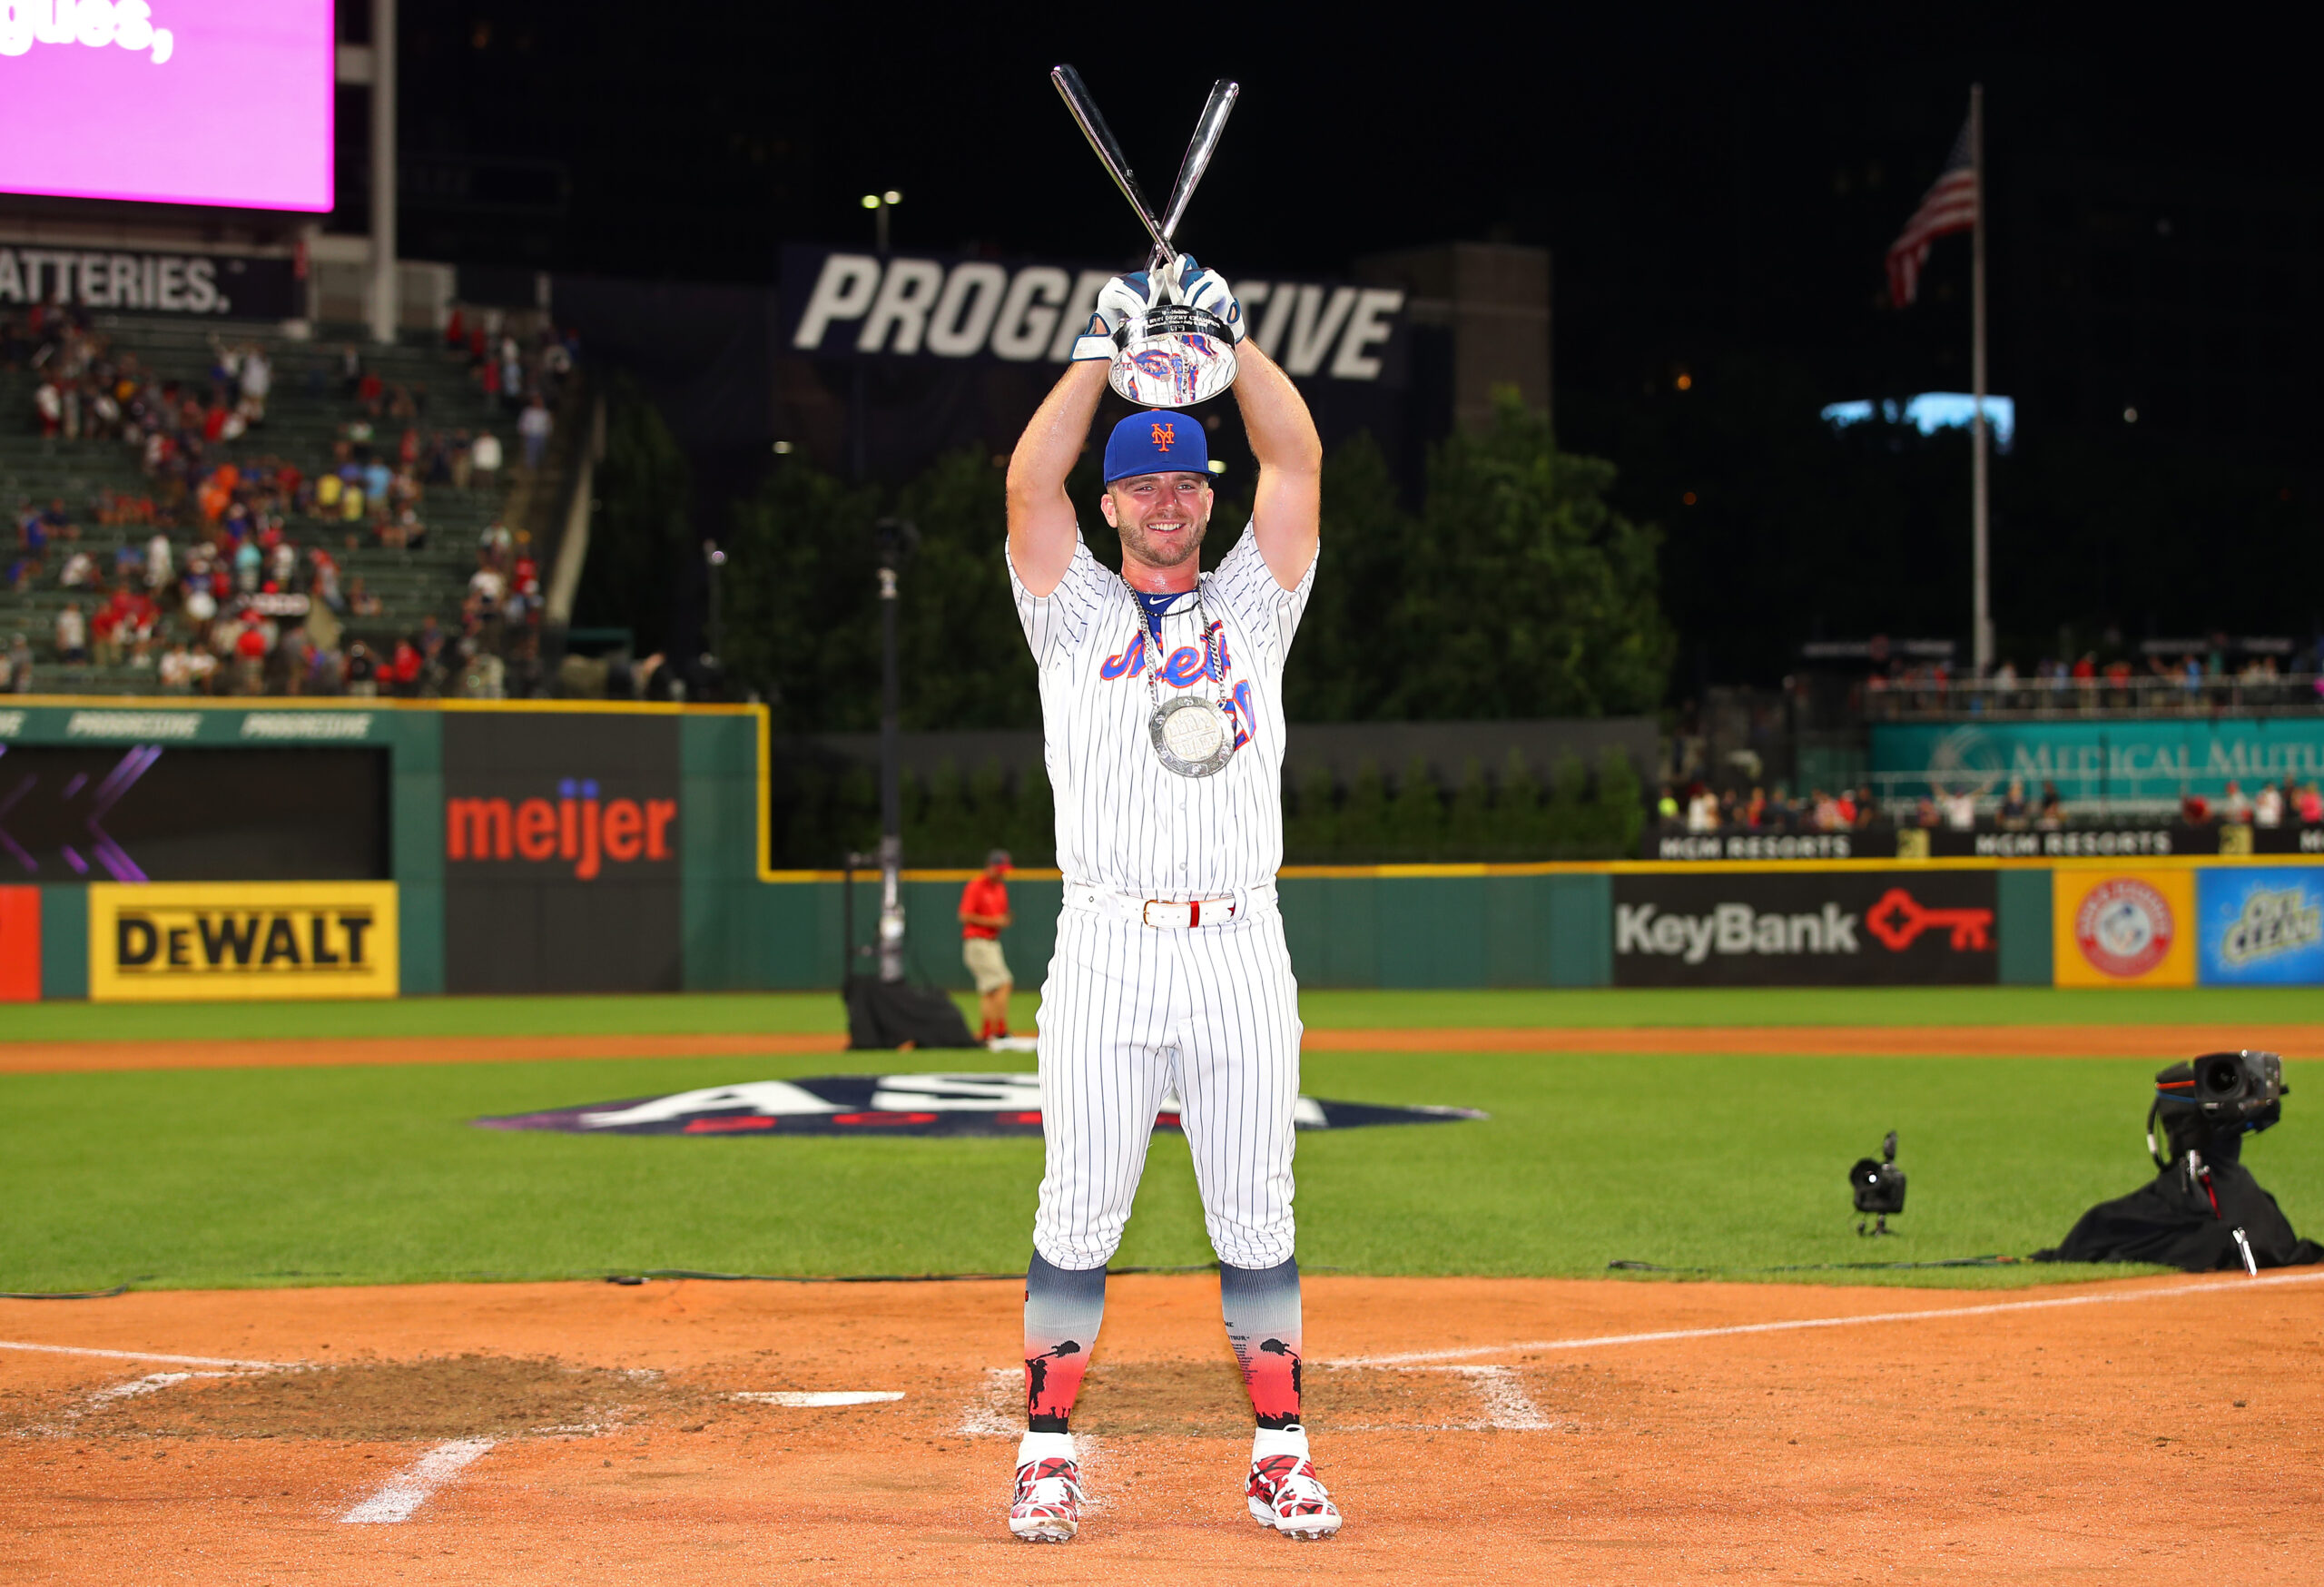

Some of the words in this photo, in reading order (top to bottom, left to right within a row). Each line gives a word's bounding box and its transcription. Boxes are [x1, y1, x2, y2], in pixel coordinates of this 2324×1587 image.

[793, 253, 1404, 380] PROGIVE
[448, 779, 676, 879] meijer
[1659, 835, 1719, 859] MGM
[1728, 833, 1850, 858] RESORTS
[1975, 833, 2039, 857] MGM
[2044, 831, 2172, 855] RESORTS
[1616, 904, 1858, 964] KeyBank
